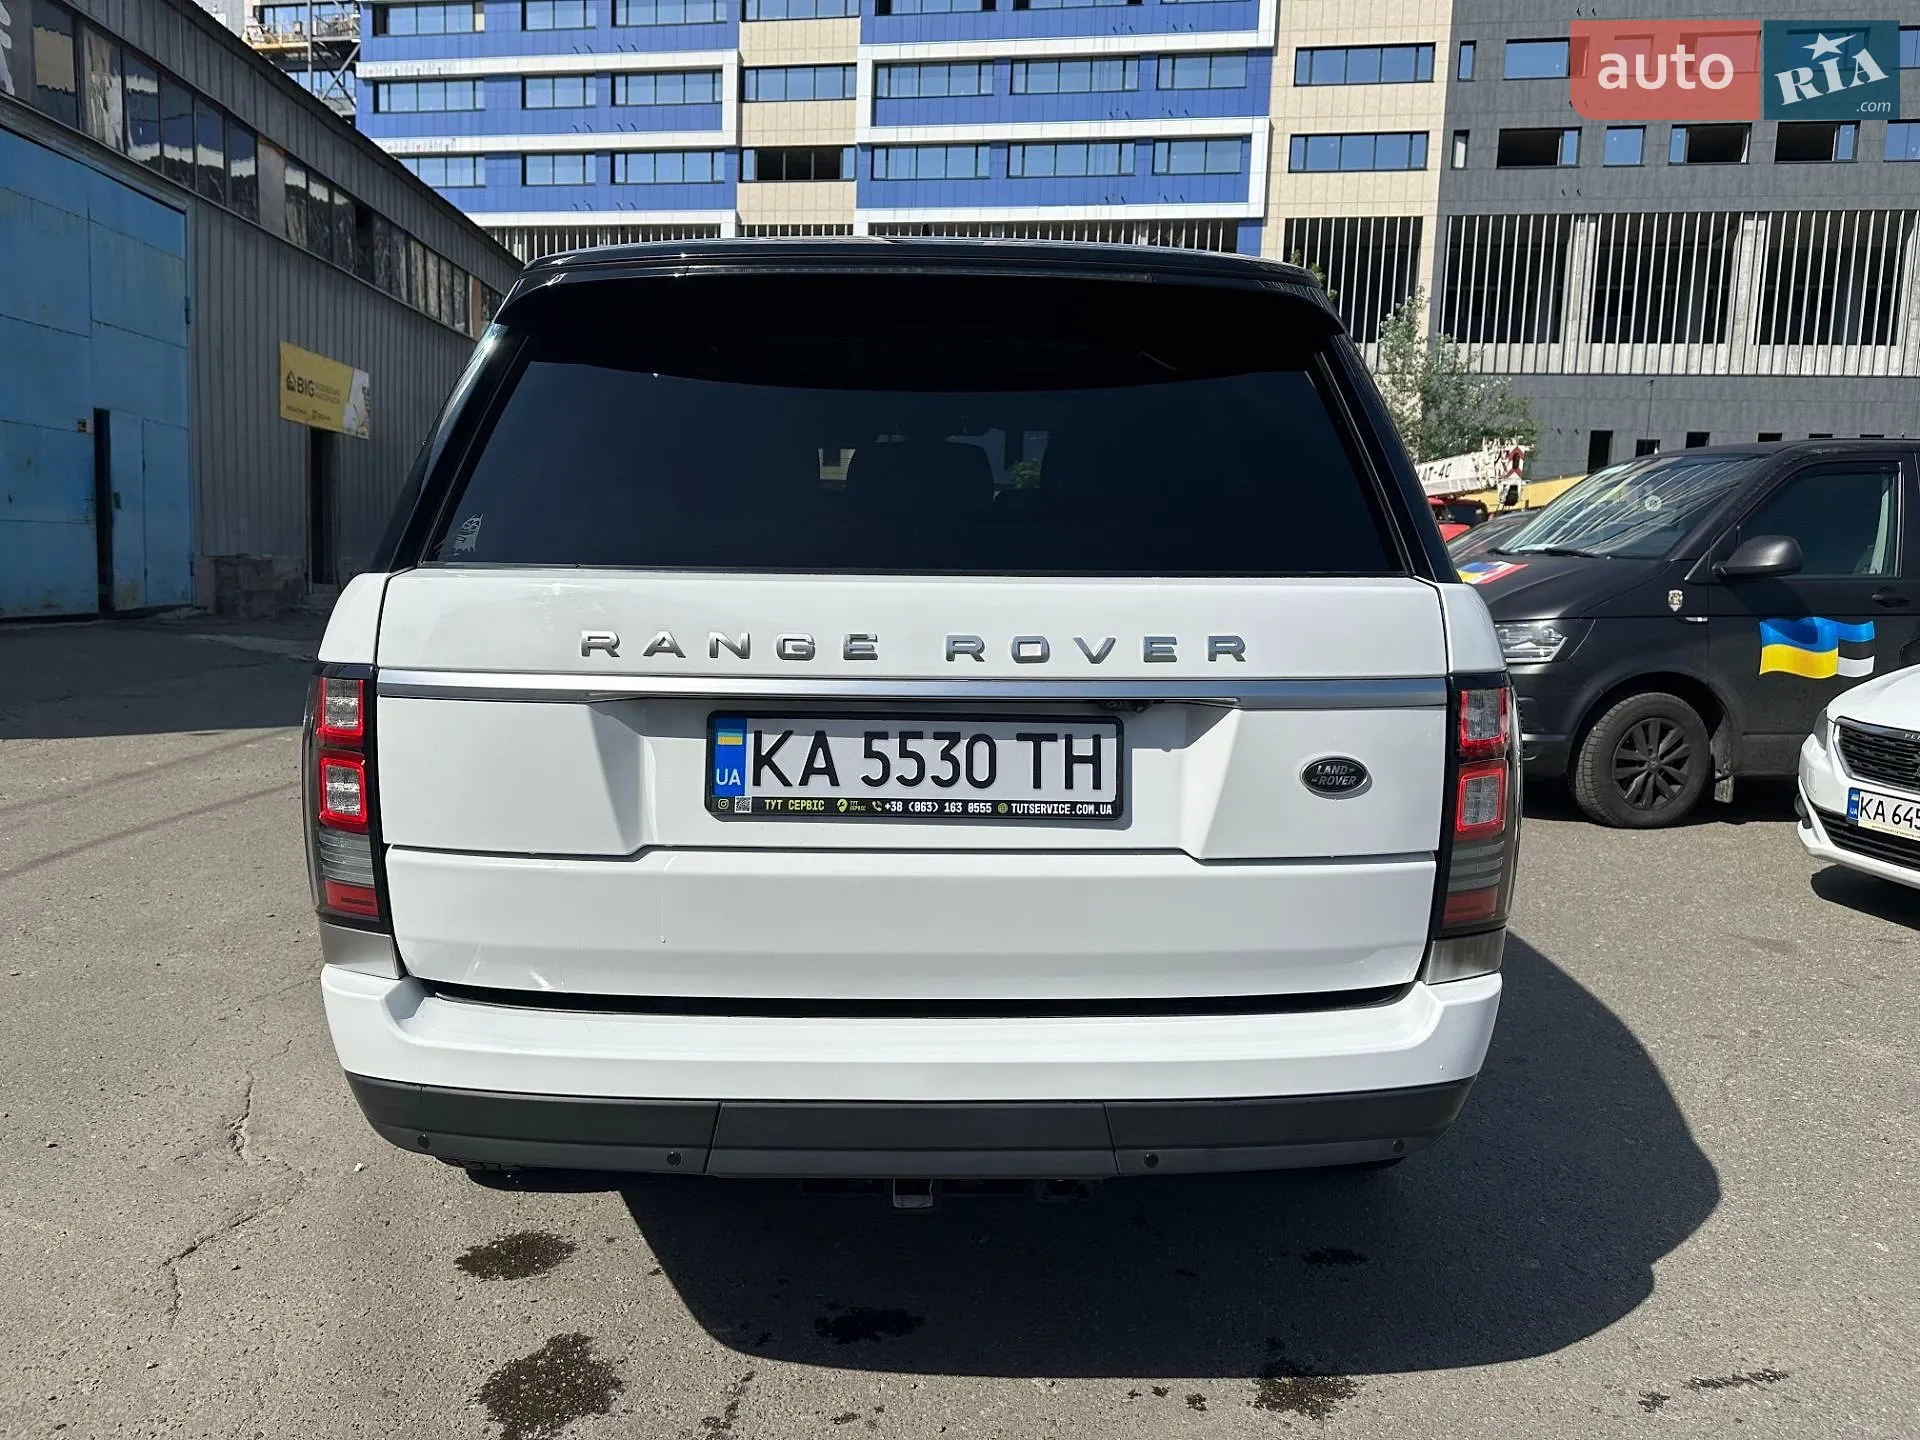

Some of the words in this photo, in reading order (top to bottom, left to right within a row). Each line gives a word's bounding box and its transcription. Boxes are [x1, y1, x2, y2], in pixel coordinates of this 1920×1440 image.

[297, 376, 314, 398] BIG
[580, 630, 879, 662] RANGE
[945, 633, 1247, 665] ROVER
[752, 729, 840, 788] KA
[860, 730, 997, 789] 5530
[1015, 732, 1102, 791] TH
[716, 769, 742, 787] UA
[764, 799, 783, 810] ТУТ
[788, 799, 825, 811] СЕРВІС
[884, 801, 903, 812] +38
[908, 800, 939, 813] (063)
[944, 801, 963, 813] 163
[1011, 803, 1113, 815] TUTSERVICE.COM.UA
[1850, 807, 1858, 816] UA
[1860, 796, 1885, 822] KA
